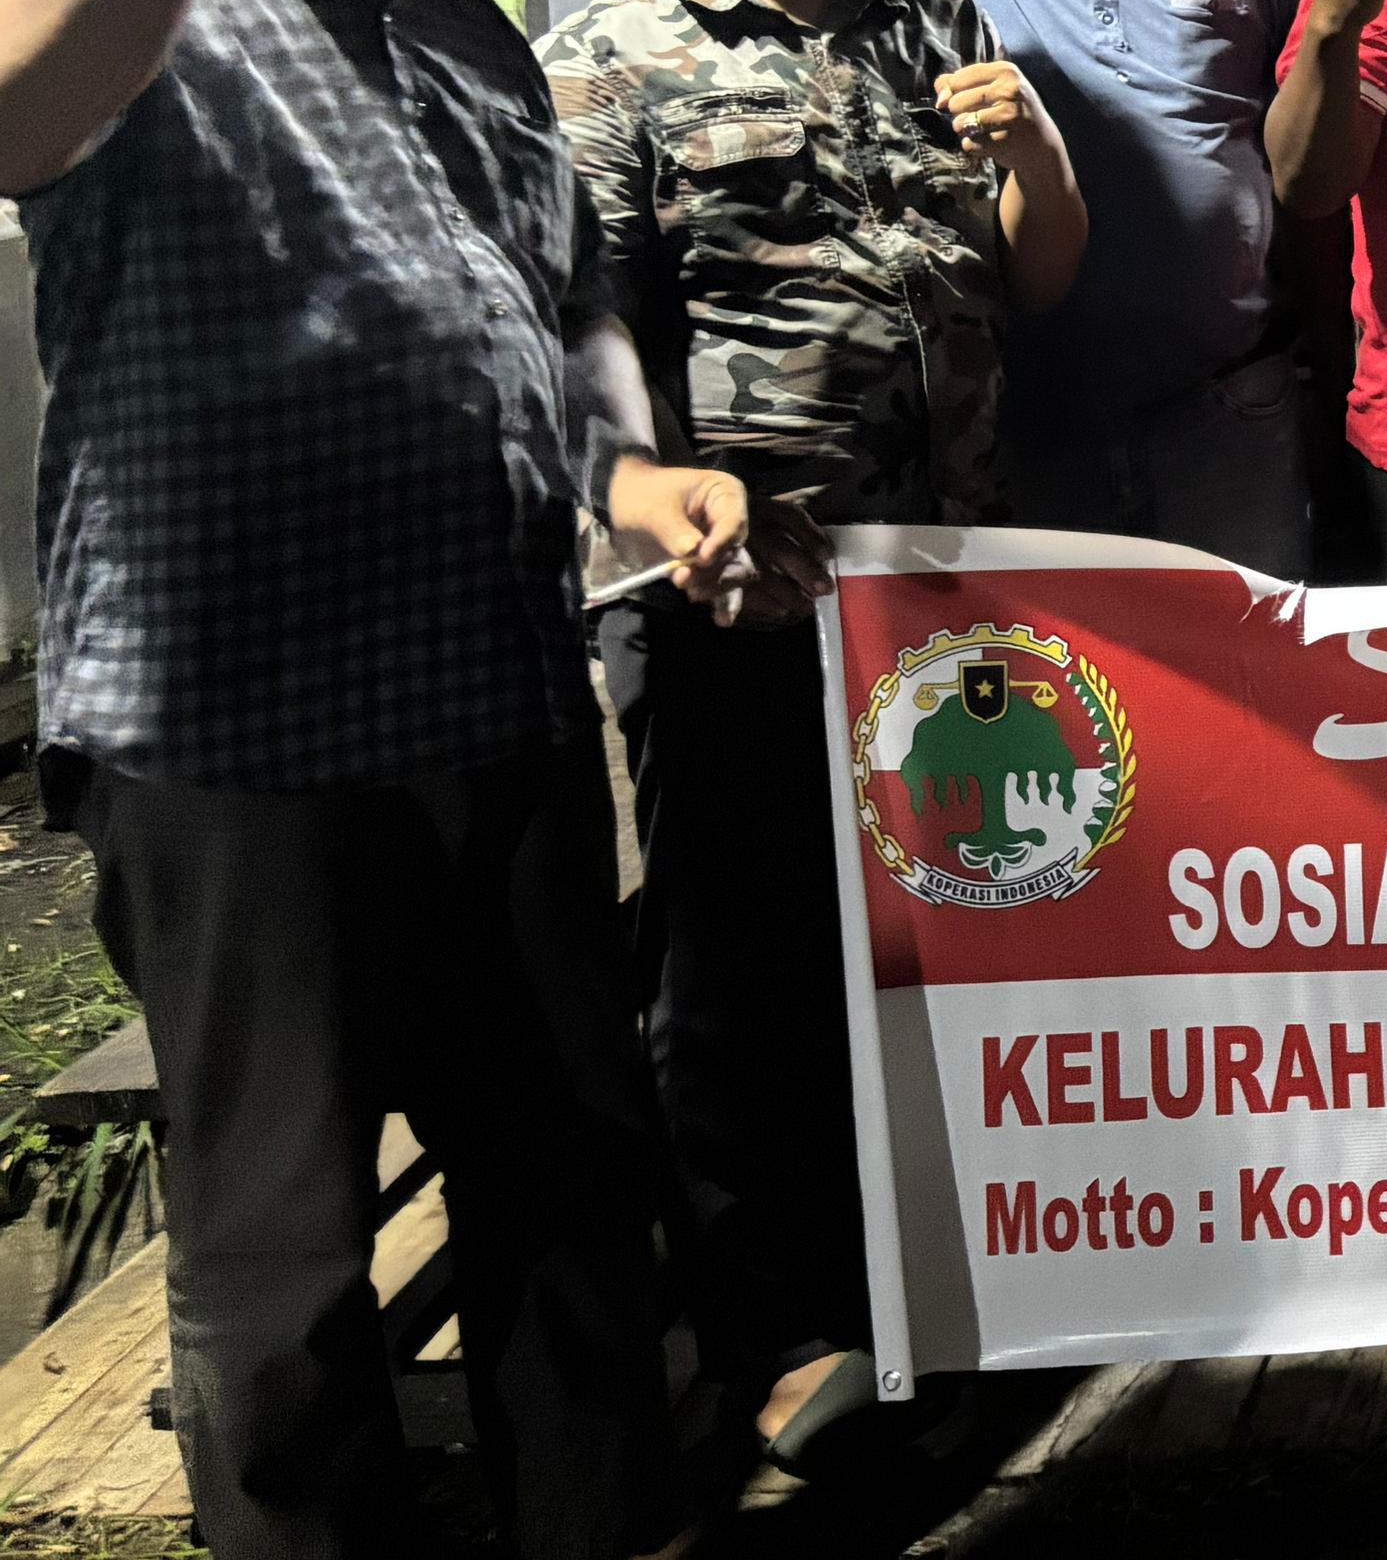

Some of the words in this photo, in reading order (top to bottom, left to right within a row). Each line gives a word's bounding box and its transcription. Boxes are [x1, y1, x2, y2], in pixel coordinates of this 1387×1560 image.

[926, 872, 991, 902] KOPERASI
[995, 869, 1066, 901] INDONESIA
[985, 1175, 1175, 1257] Motto
